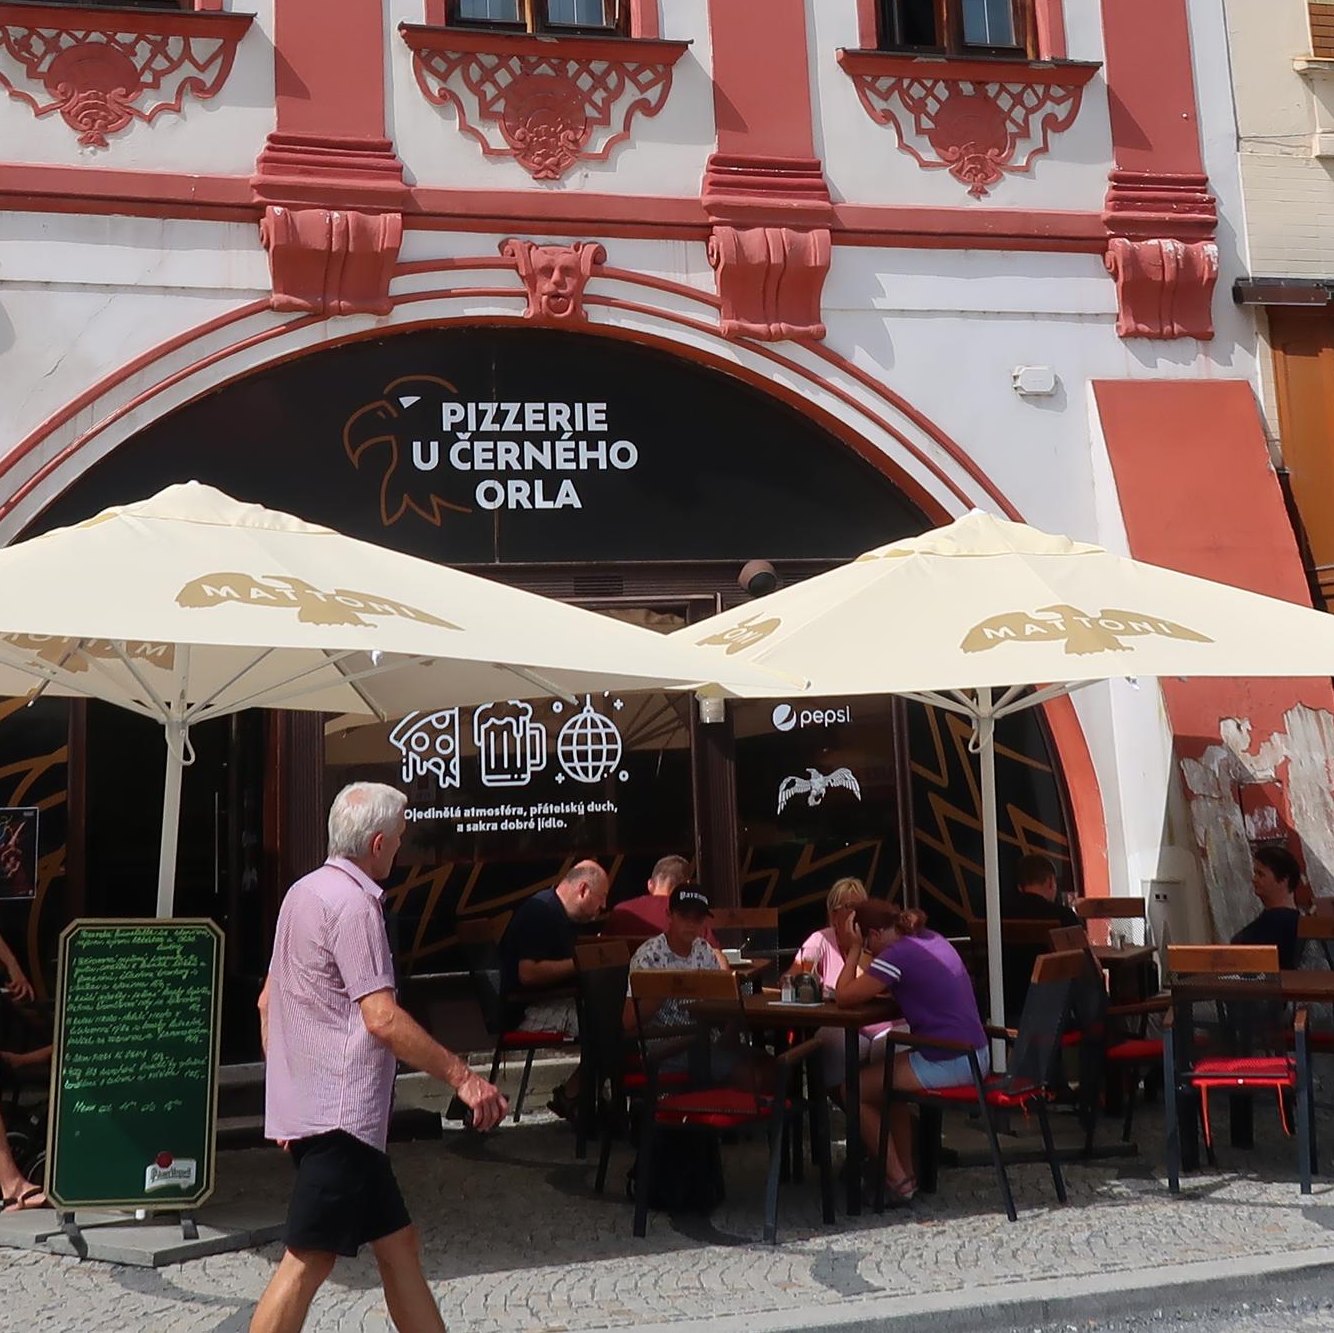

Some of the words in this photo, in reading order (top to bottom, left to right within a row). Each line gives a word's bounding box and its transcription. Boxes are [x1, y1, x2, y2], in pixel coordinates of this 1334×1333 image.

[442, 402, 608, 432] PIZZERIE
[412, 441, 439, 471] U
[449, 432, 639, 471] ČERNÉHO
[475, 479, 583, 510] ORLA
[201, 583, 417, 618] MATTONI
[983, 617, 1173, 640] MATTONI
[800, 705, 851, 728] pepsi
[463, 804, 528, 819] atmosféra,
[529, 801, 585, 821] přátelský
[587, 800, 618, 814] duch,
[457, 824, 464, 833] a
[466, 820, 498, 832] sakra
[500, 818, 535, 831] dobré
